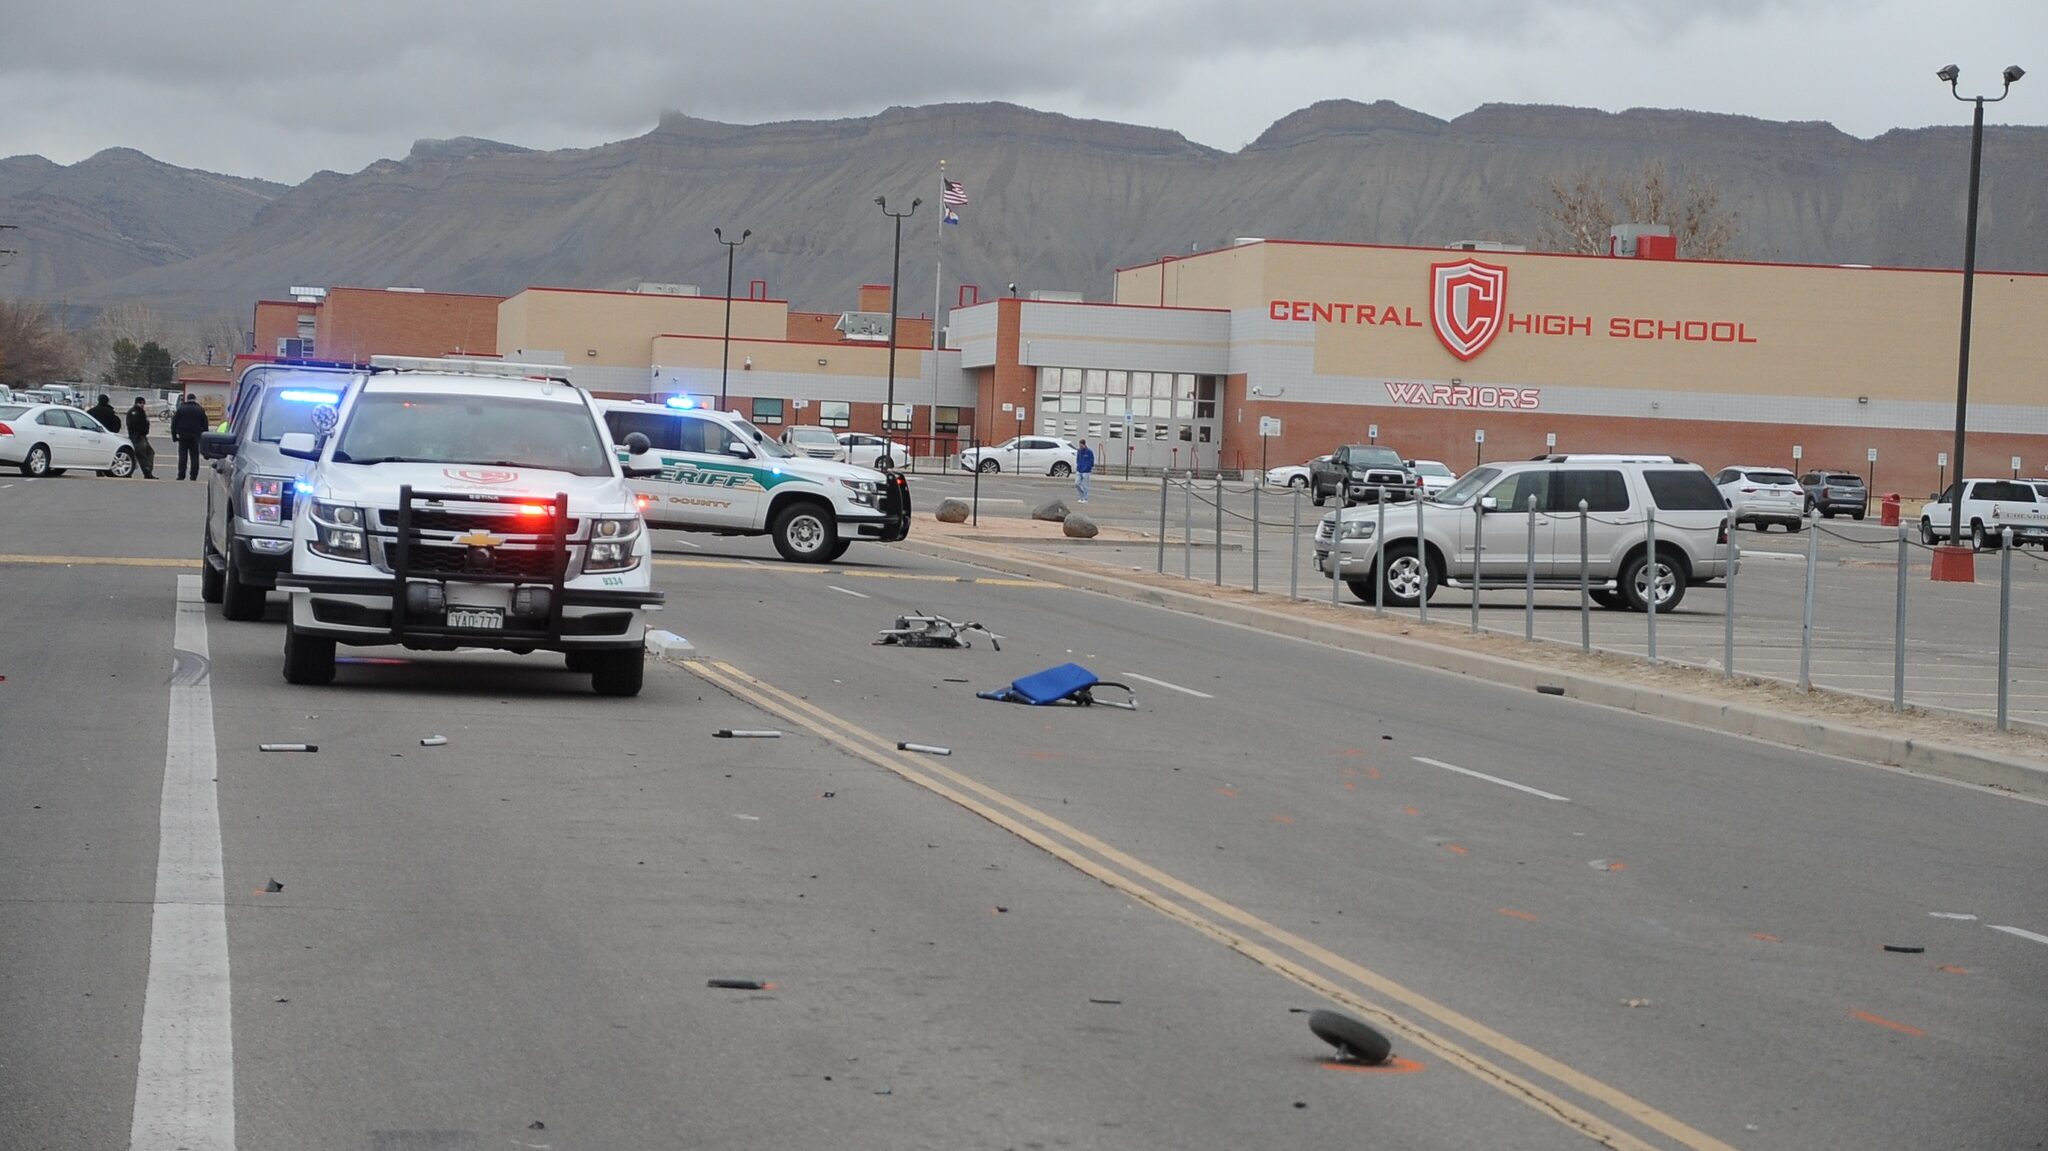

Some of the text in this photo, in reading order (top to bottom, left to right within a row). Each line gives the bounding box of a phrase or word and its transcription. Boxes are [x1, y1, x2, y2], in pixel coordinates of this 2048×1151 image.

[1269, 300, 1757, 343] CENTRAL HIGH SCHOOL
[1385, 382, 1541, 409] WARRIORS
[641, 466, 753, 488] ERIFF
[669, 496, 731, 509] COUNTY
[2006, 512, 2048, 520] CHEVRO
